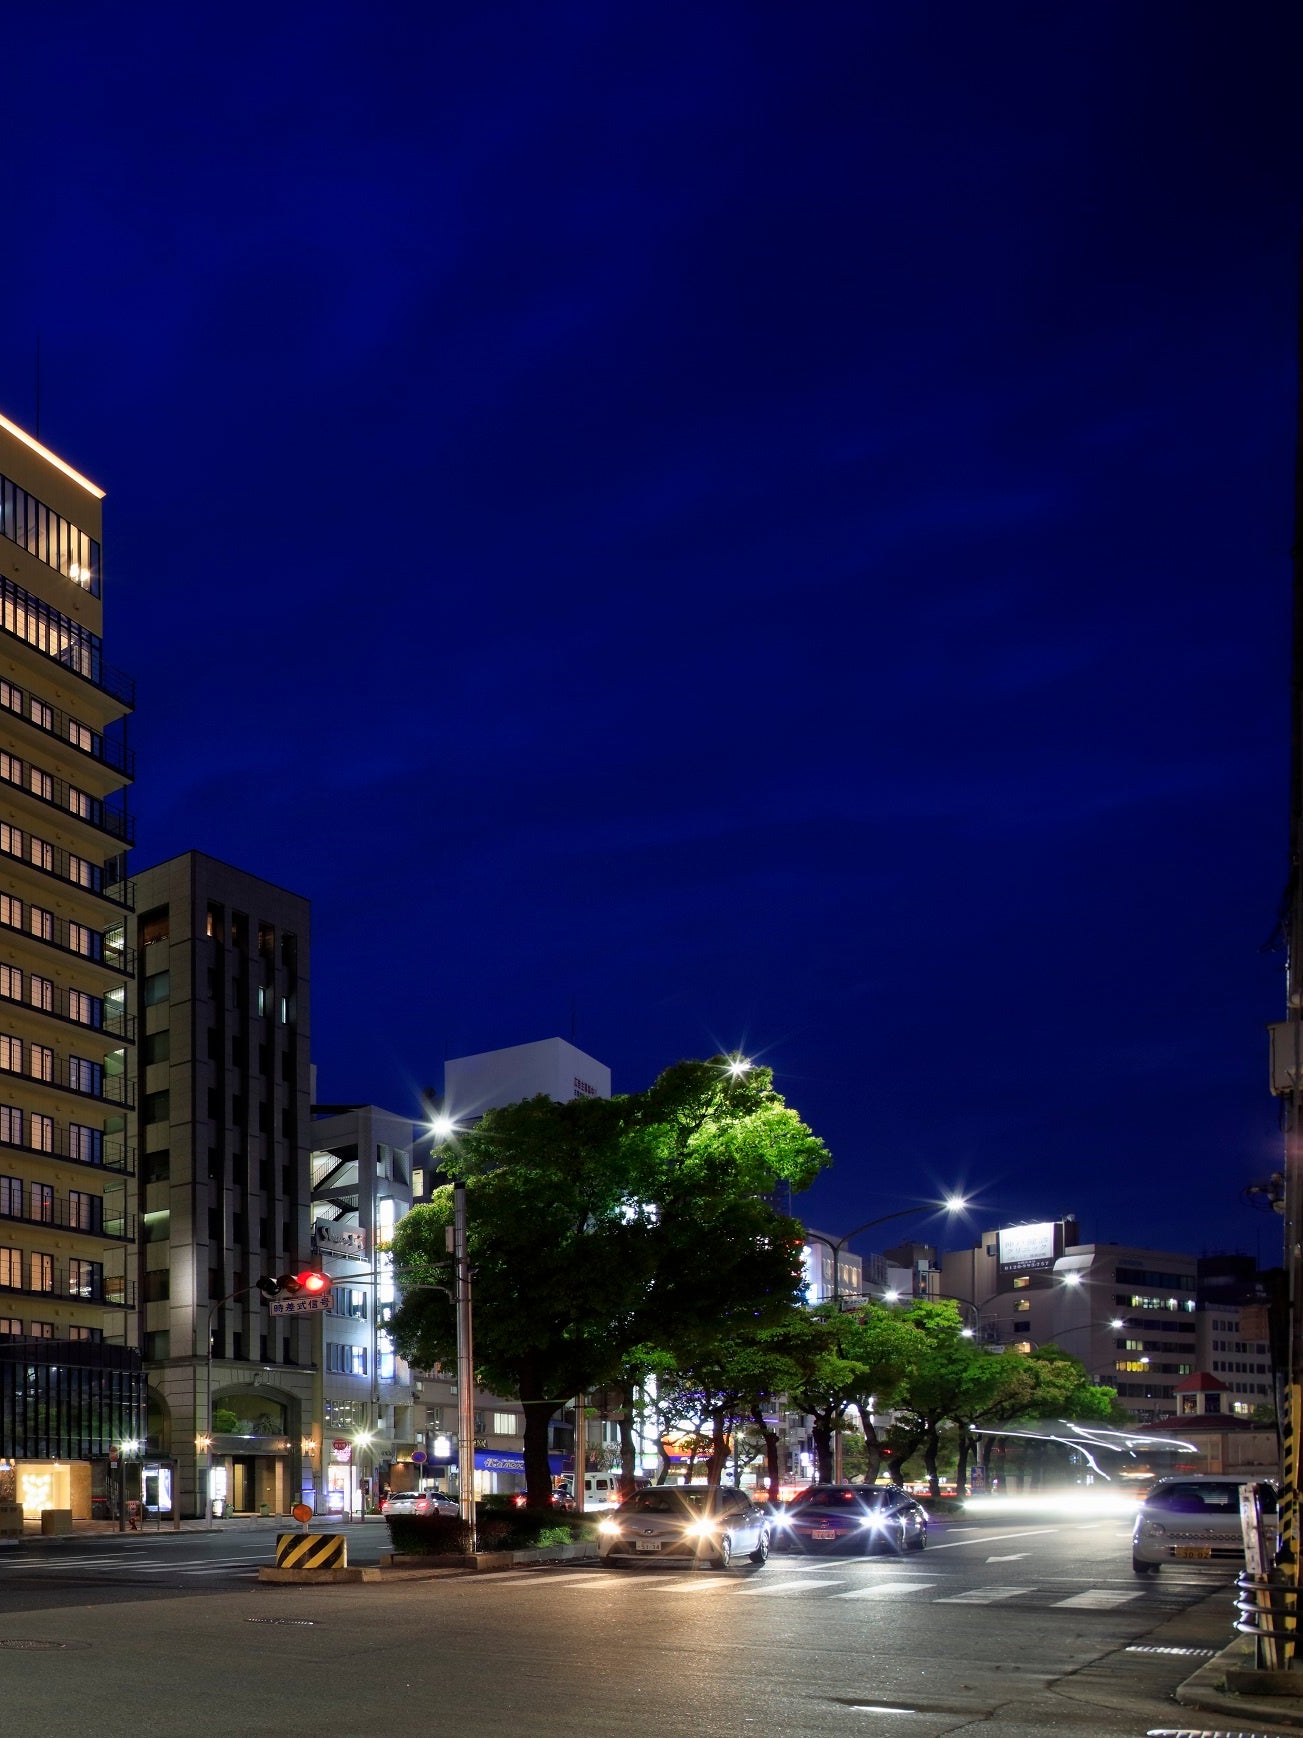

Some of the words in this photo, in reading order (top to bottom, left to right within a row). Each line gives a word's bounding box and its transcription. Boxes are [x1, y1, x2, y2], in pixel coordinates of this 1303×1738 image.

[273, 1296, 331, 1313] 時差式信号
